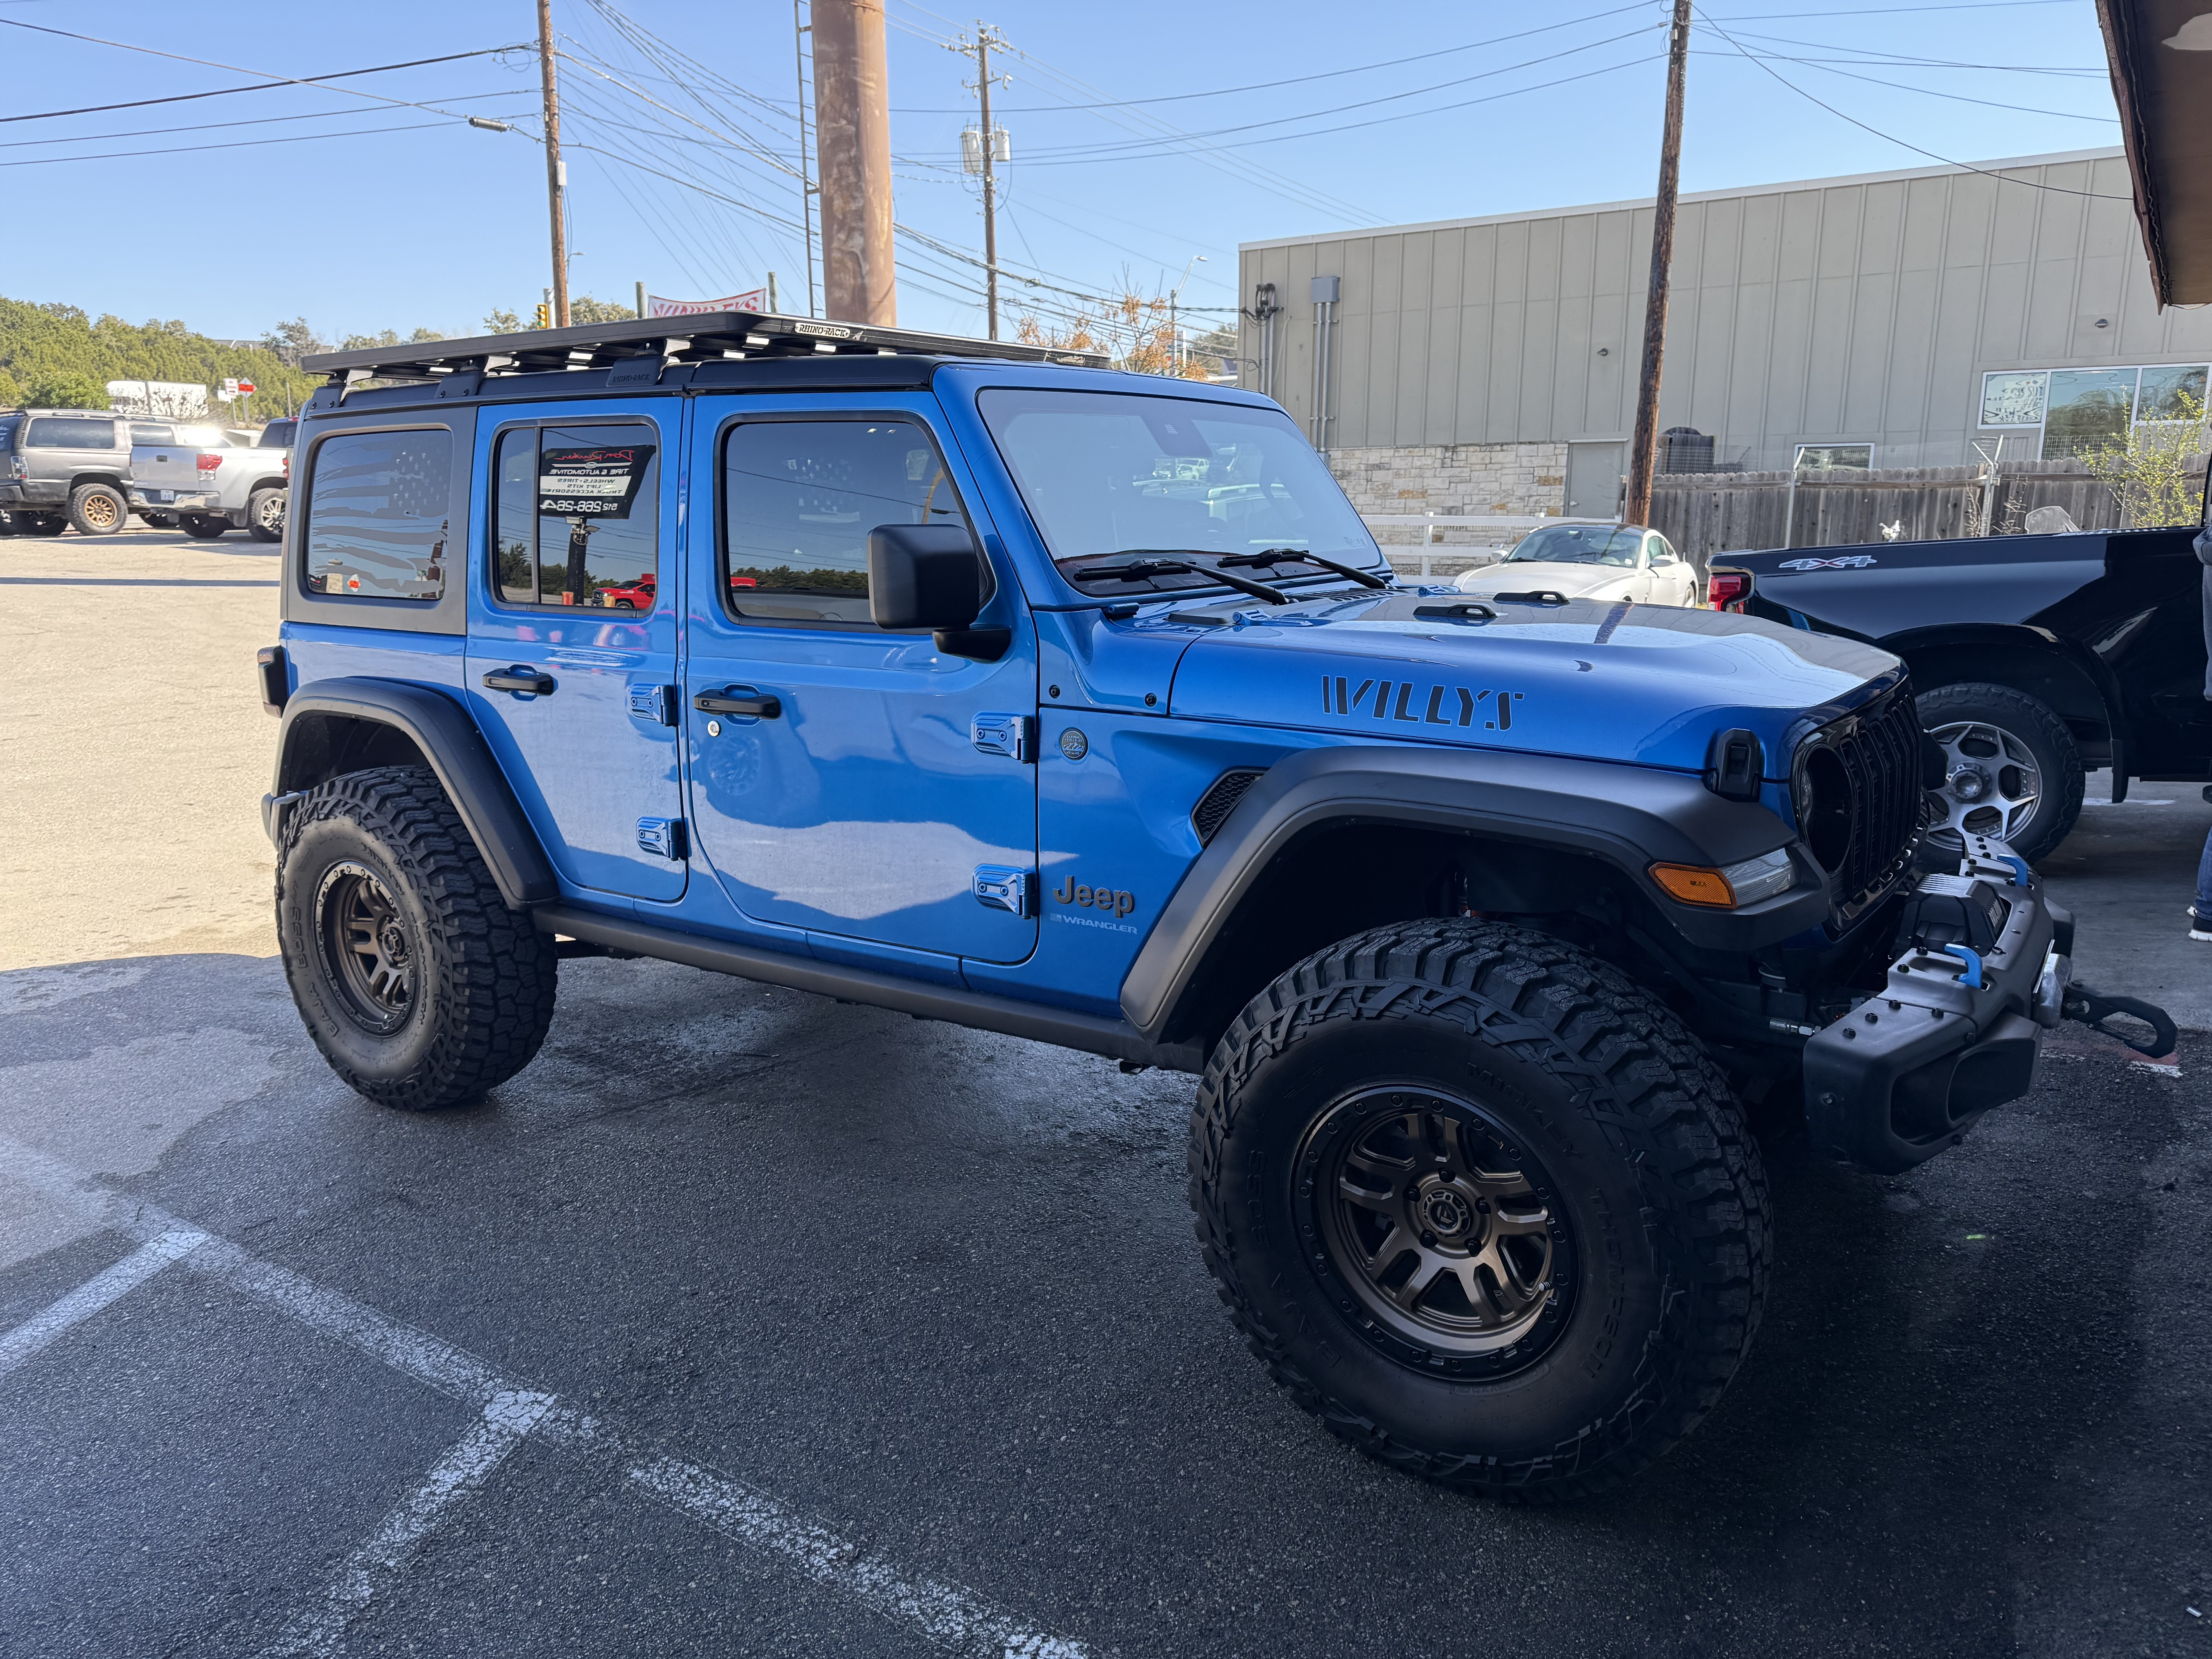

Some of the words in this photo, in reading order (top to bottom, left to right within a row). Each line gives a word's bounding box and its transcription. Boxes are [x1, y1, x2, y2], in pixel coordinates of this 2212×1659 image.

[799, 324, 847, 337] RHINO-RACK
[613, 373, 651, 382] RHINO-RACK
[1322, 675, 1525, 731] WILLYS
[1053, 875, 1135, 918] Jeep
[289, 907, 309, 969] BOSS
[1063, 915, 1138, 934] WRANGLER
[307, 982, 340, 1037] BAJA
